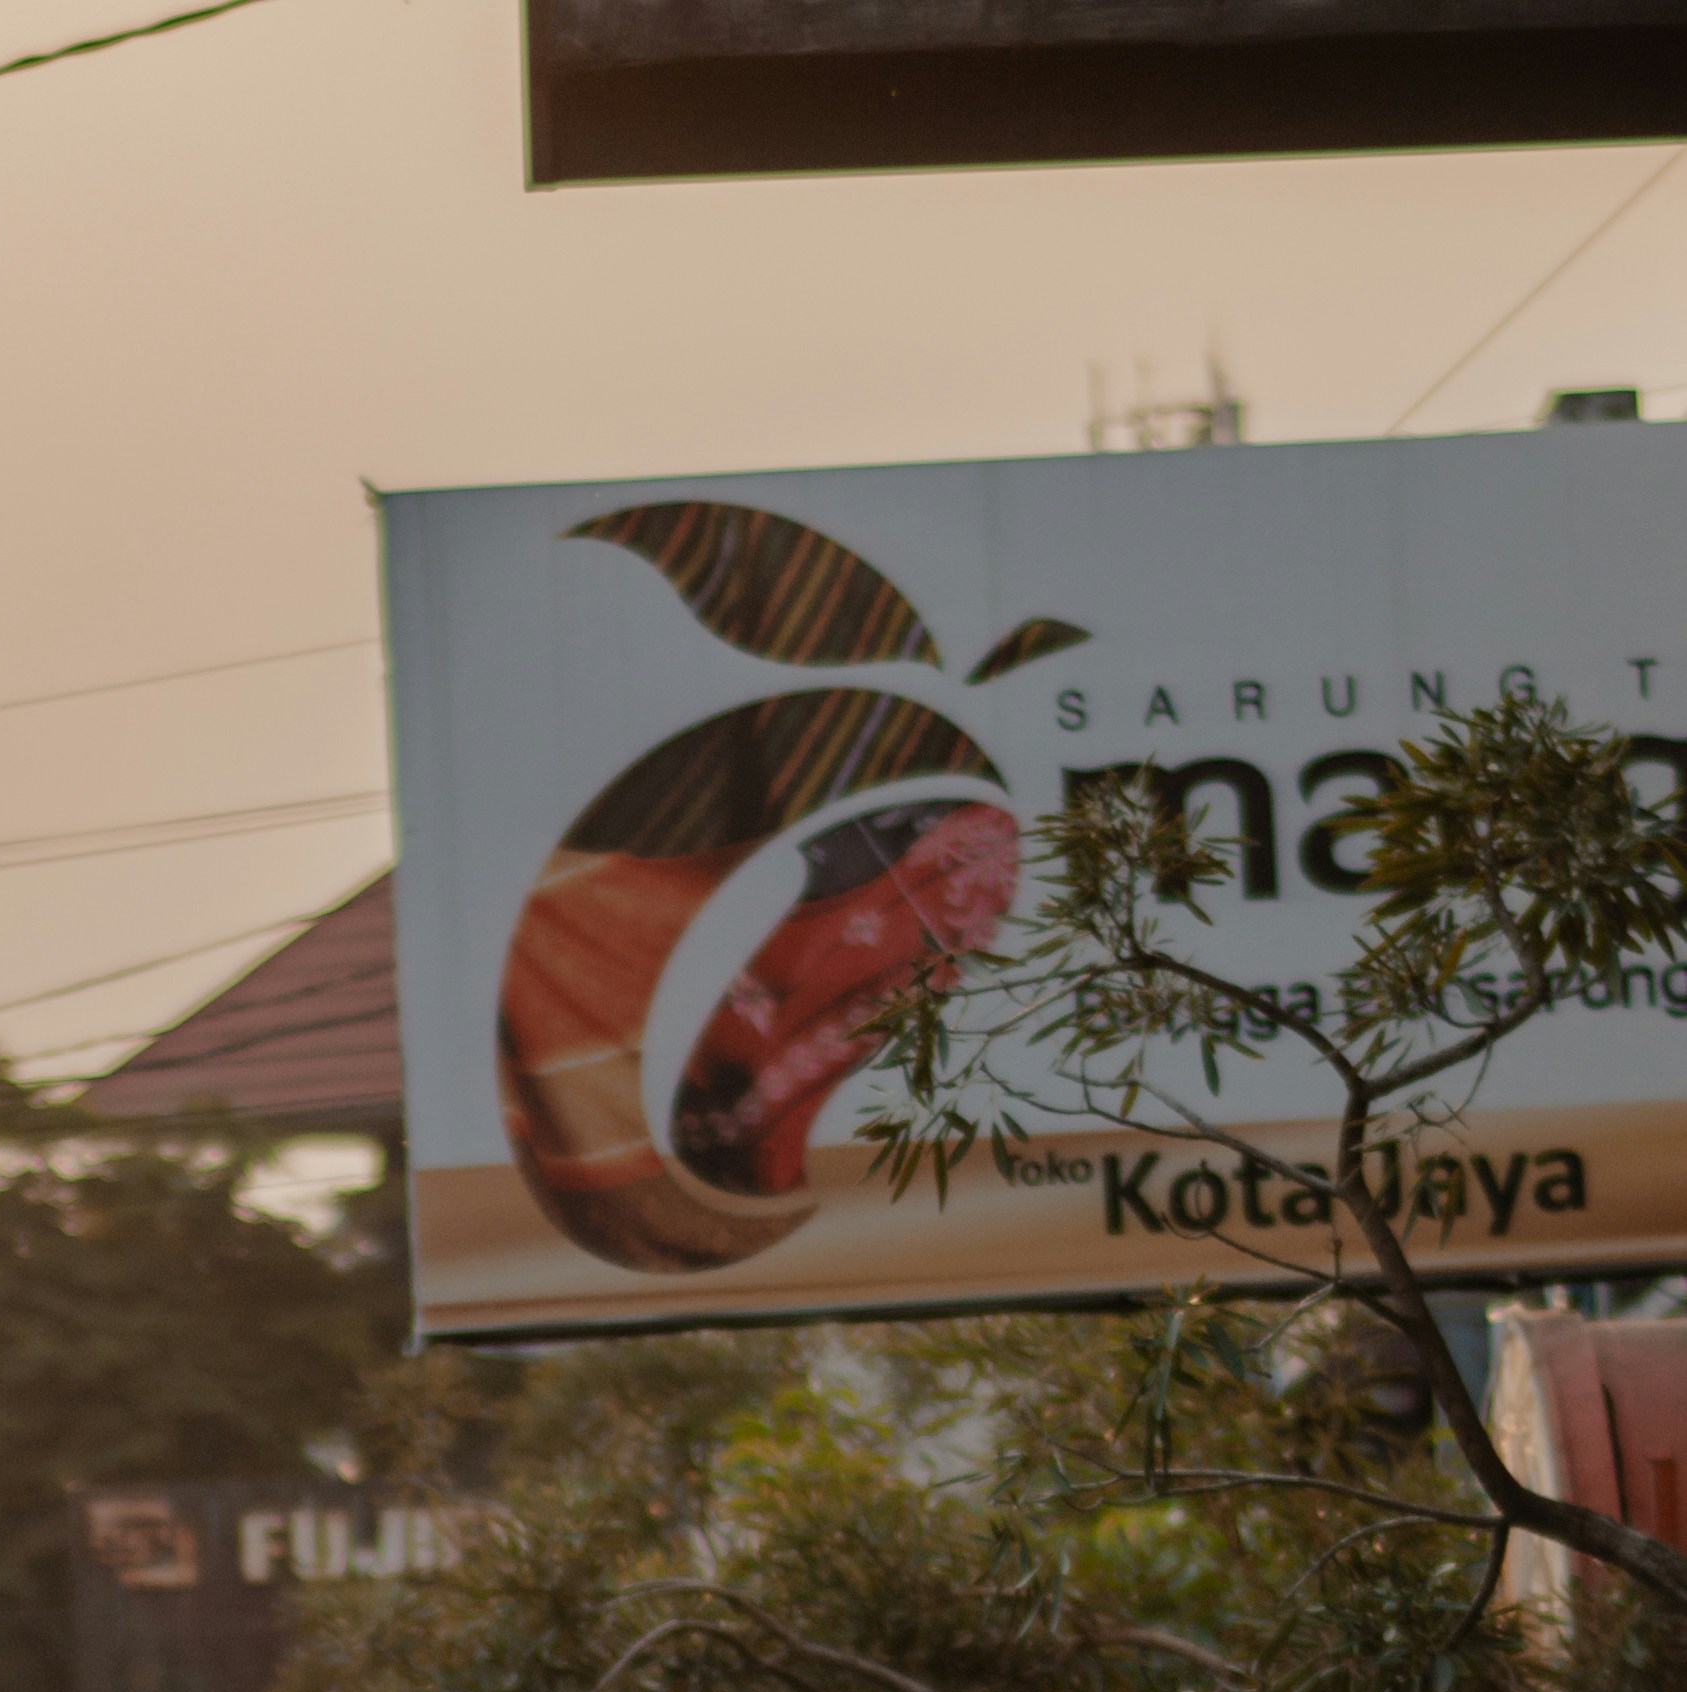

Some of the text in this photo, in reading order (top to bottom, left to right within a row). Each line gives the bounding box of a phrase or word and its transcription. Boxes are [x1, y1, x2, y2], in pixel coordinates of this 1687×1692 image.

[1056, 663, 1538, 731] SARUNG
[1102, 1150, 1333, 1234] Kota
[1370, 1138, 1587, 1236] Jaya
